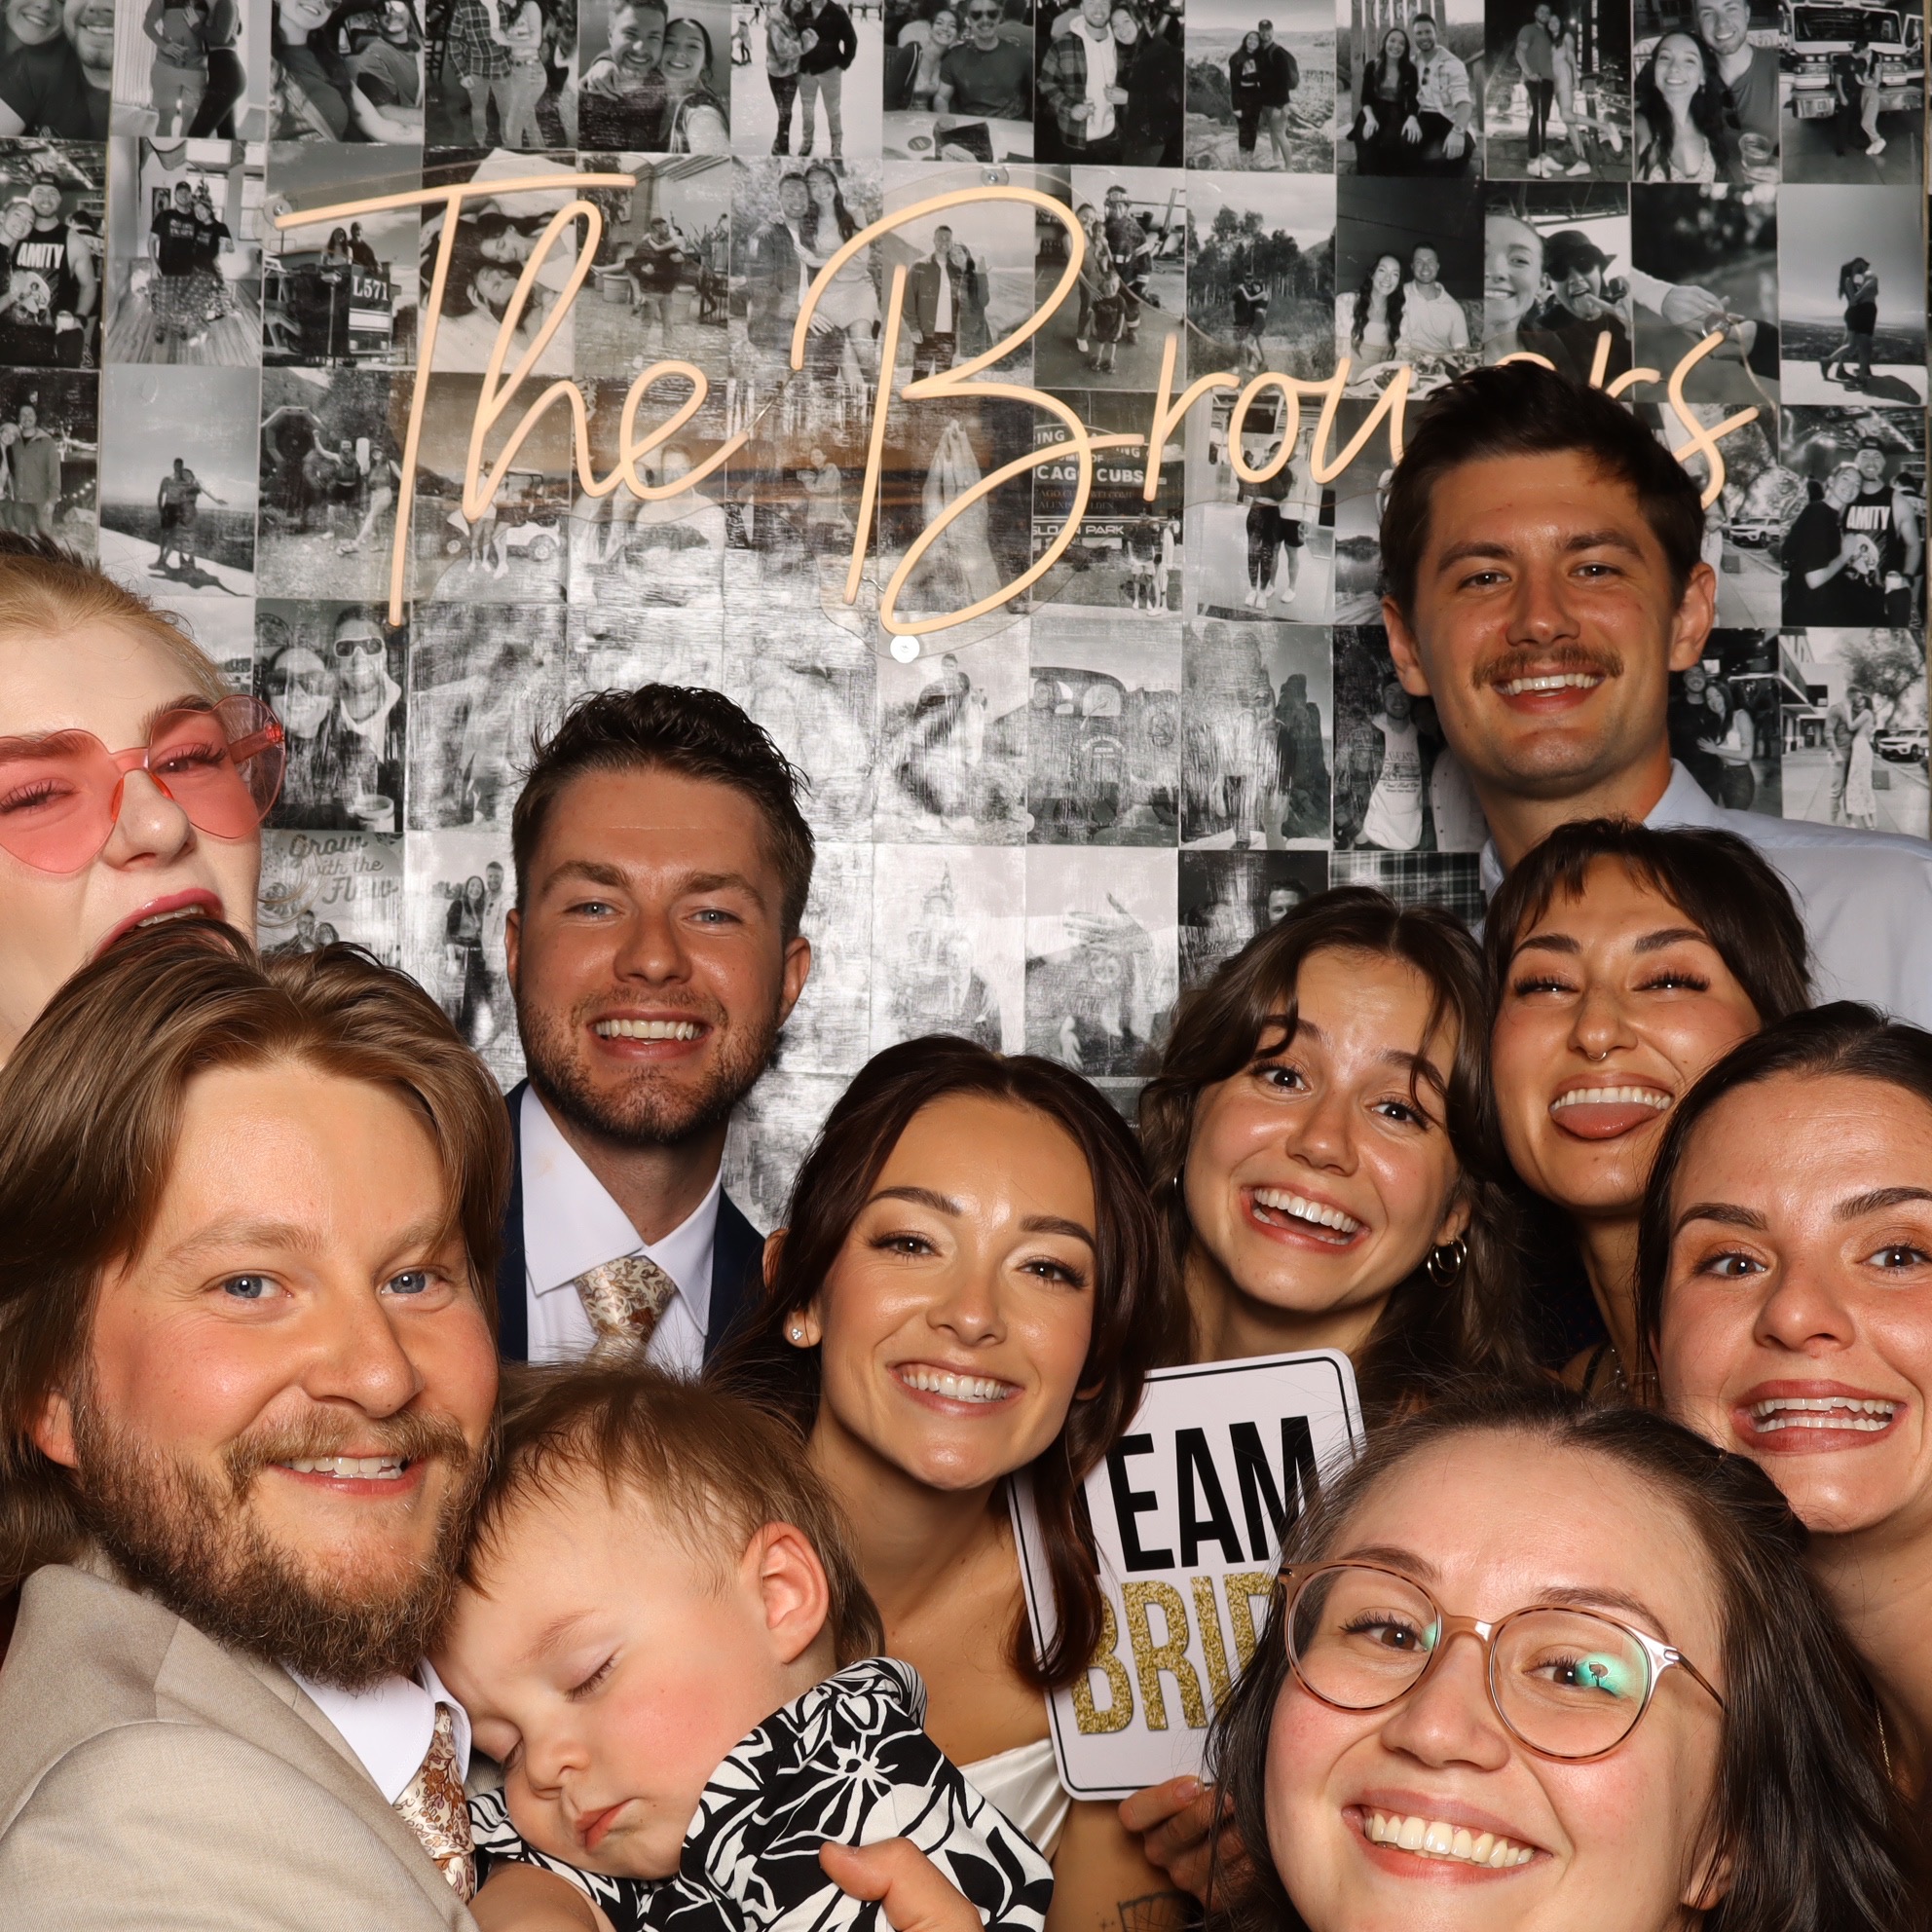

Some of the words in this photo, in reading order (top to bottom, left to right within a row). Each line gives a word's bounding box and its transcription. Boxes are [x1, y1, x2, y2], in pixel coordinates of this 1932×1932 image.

[17, 242, 65, 270] AMITY
[353, 276, 390, 302] L571
[274, 172, 751, 628] The
[790, 184, 1760, 637] Browrs
[1033, 430, 1065, 445] ING
[1033, 465, 1080, 481] CAG
[1096, 468, 1144, 483] CUBS
[1085, 525, 1125, 535] PARK
[1845, 505, 1891, 532] AMITY
[353, 855, 385, 873] the
[321, 876, 399, 905] Flw
[1079, 1414, 1320, 1577] EAM
[1068, 1571, 1279, 1736] BRI
